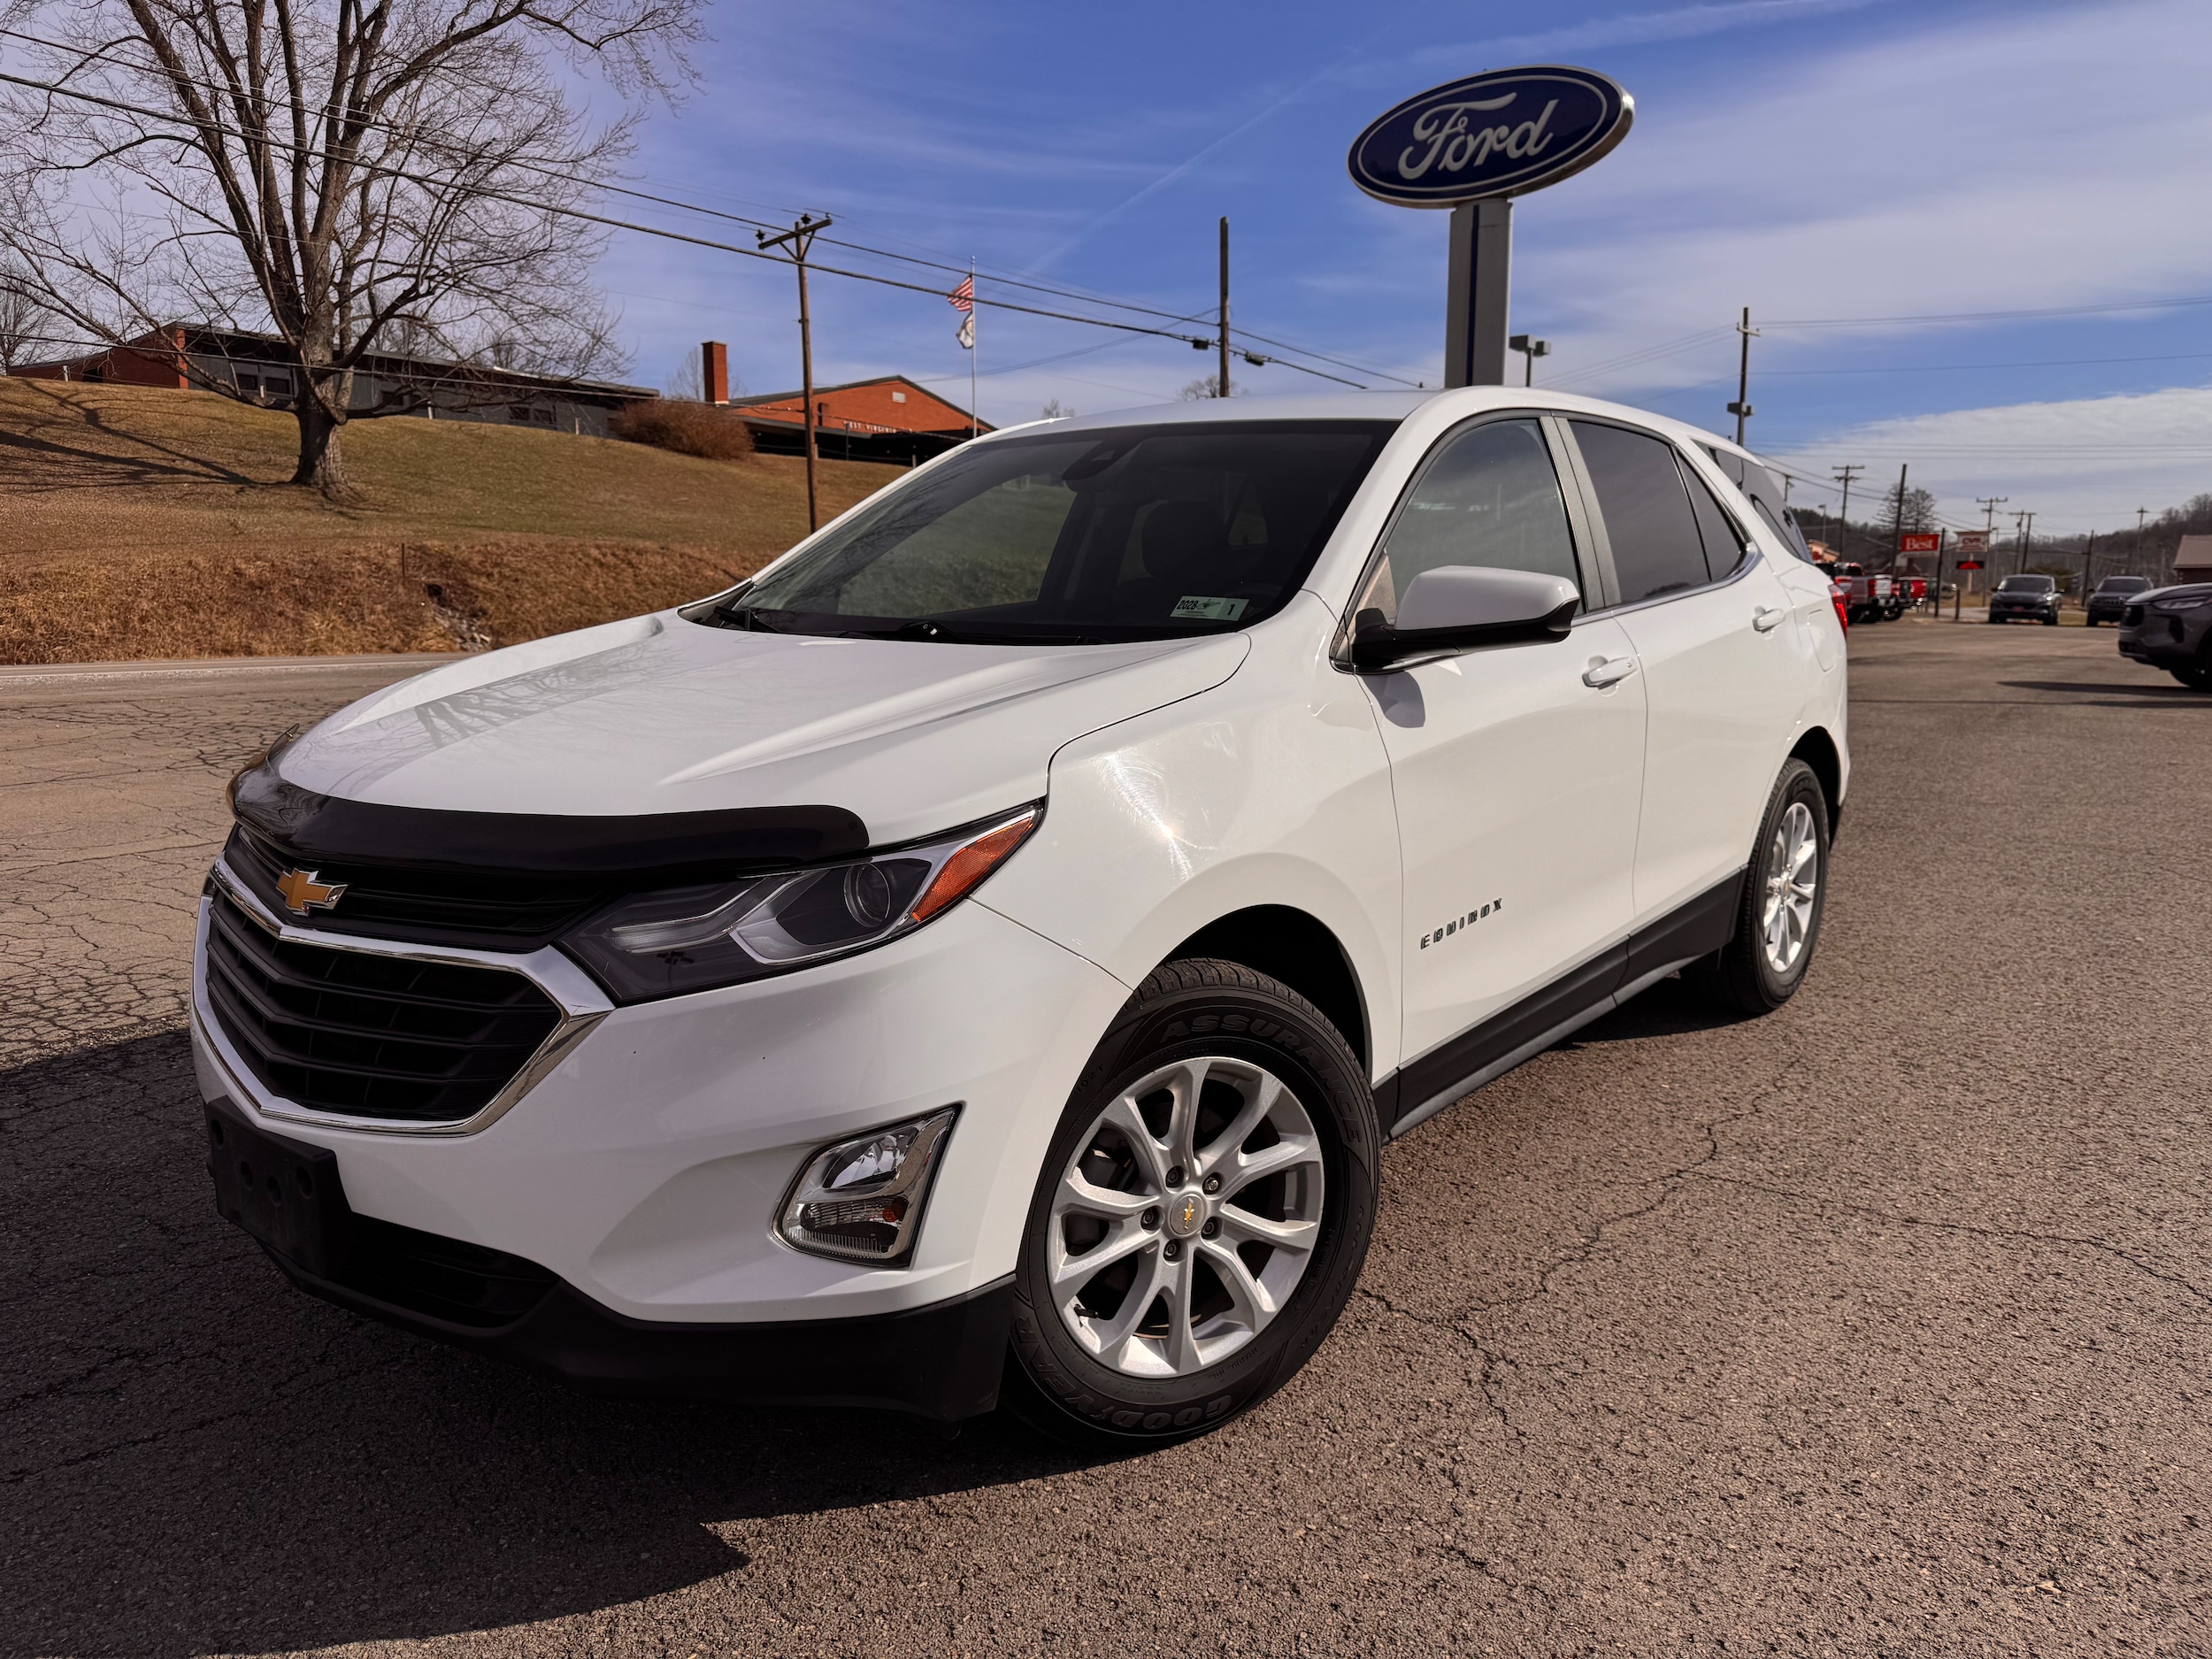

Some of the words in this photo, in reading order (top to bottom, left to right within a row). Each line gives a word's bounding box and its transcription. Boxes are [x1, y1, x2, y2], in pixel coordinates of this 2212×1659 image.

[1398, 92, 1560, 180] Ford
[1905, 537, 1934, 550] Best
[1227, 603, 1236, 616] 1
[1419, 897, 1502, 949] EQUINOX
[1076, 1064, 1105, 1094] 102T
[1160, 1014, 1361, 1144] ASSURANCE
[1010, 1314, 1233, 1430] GOODYEAR
